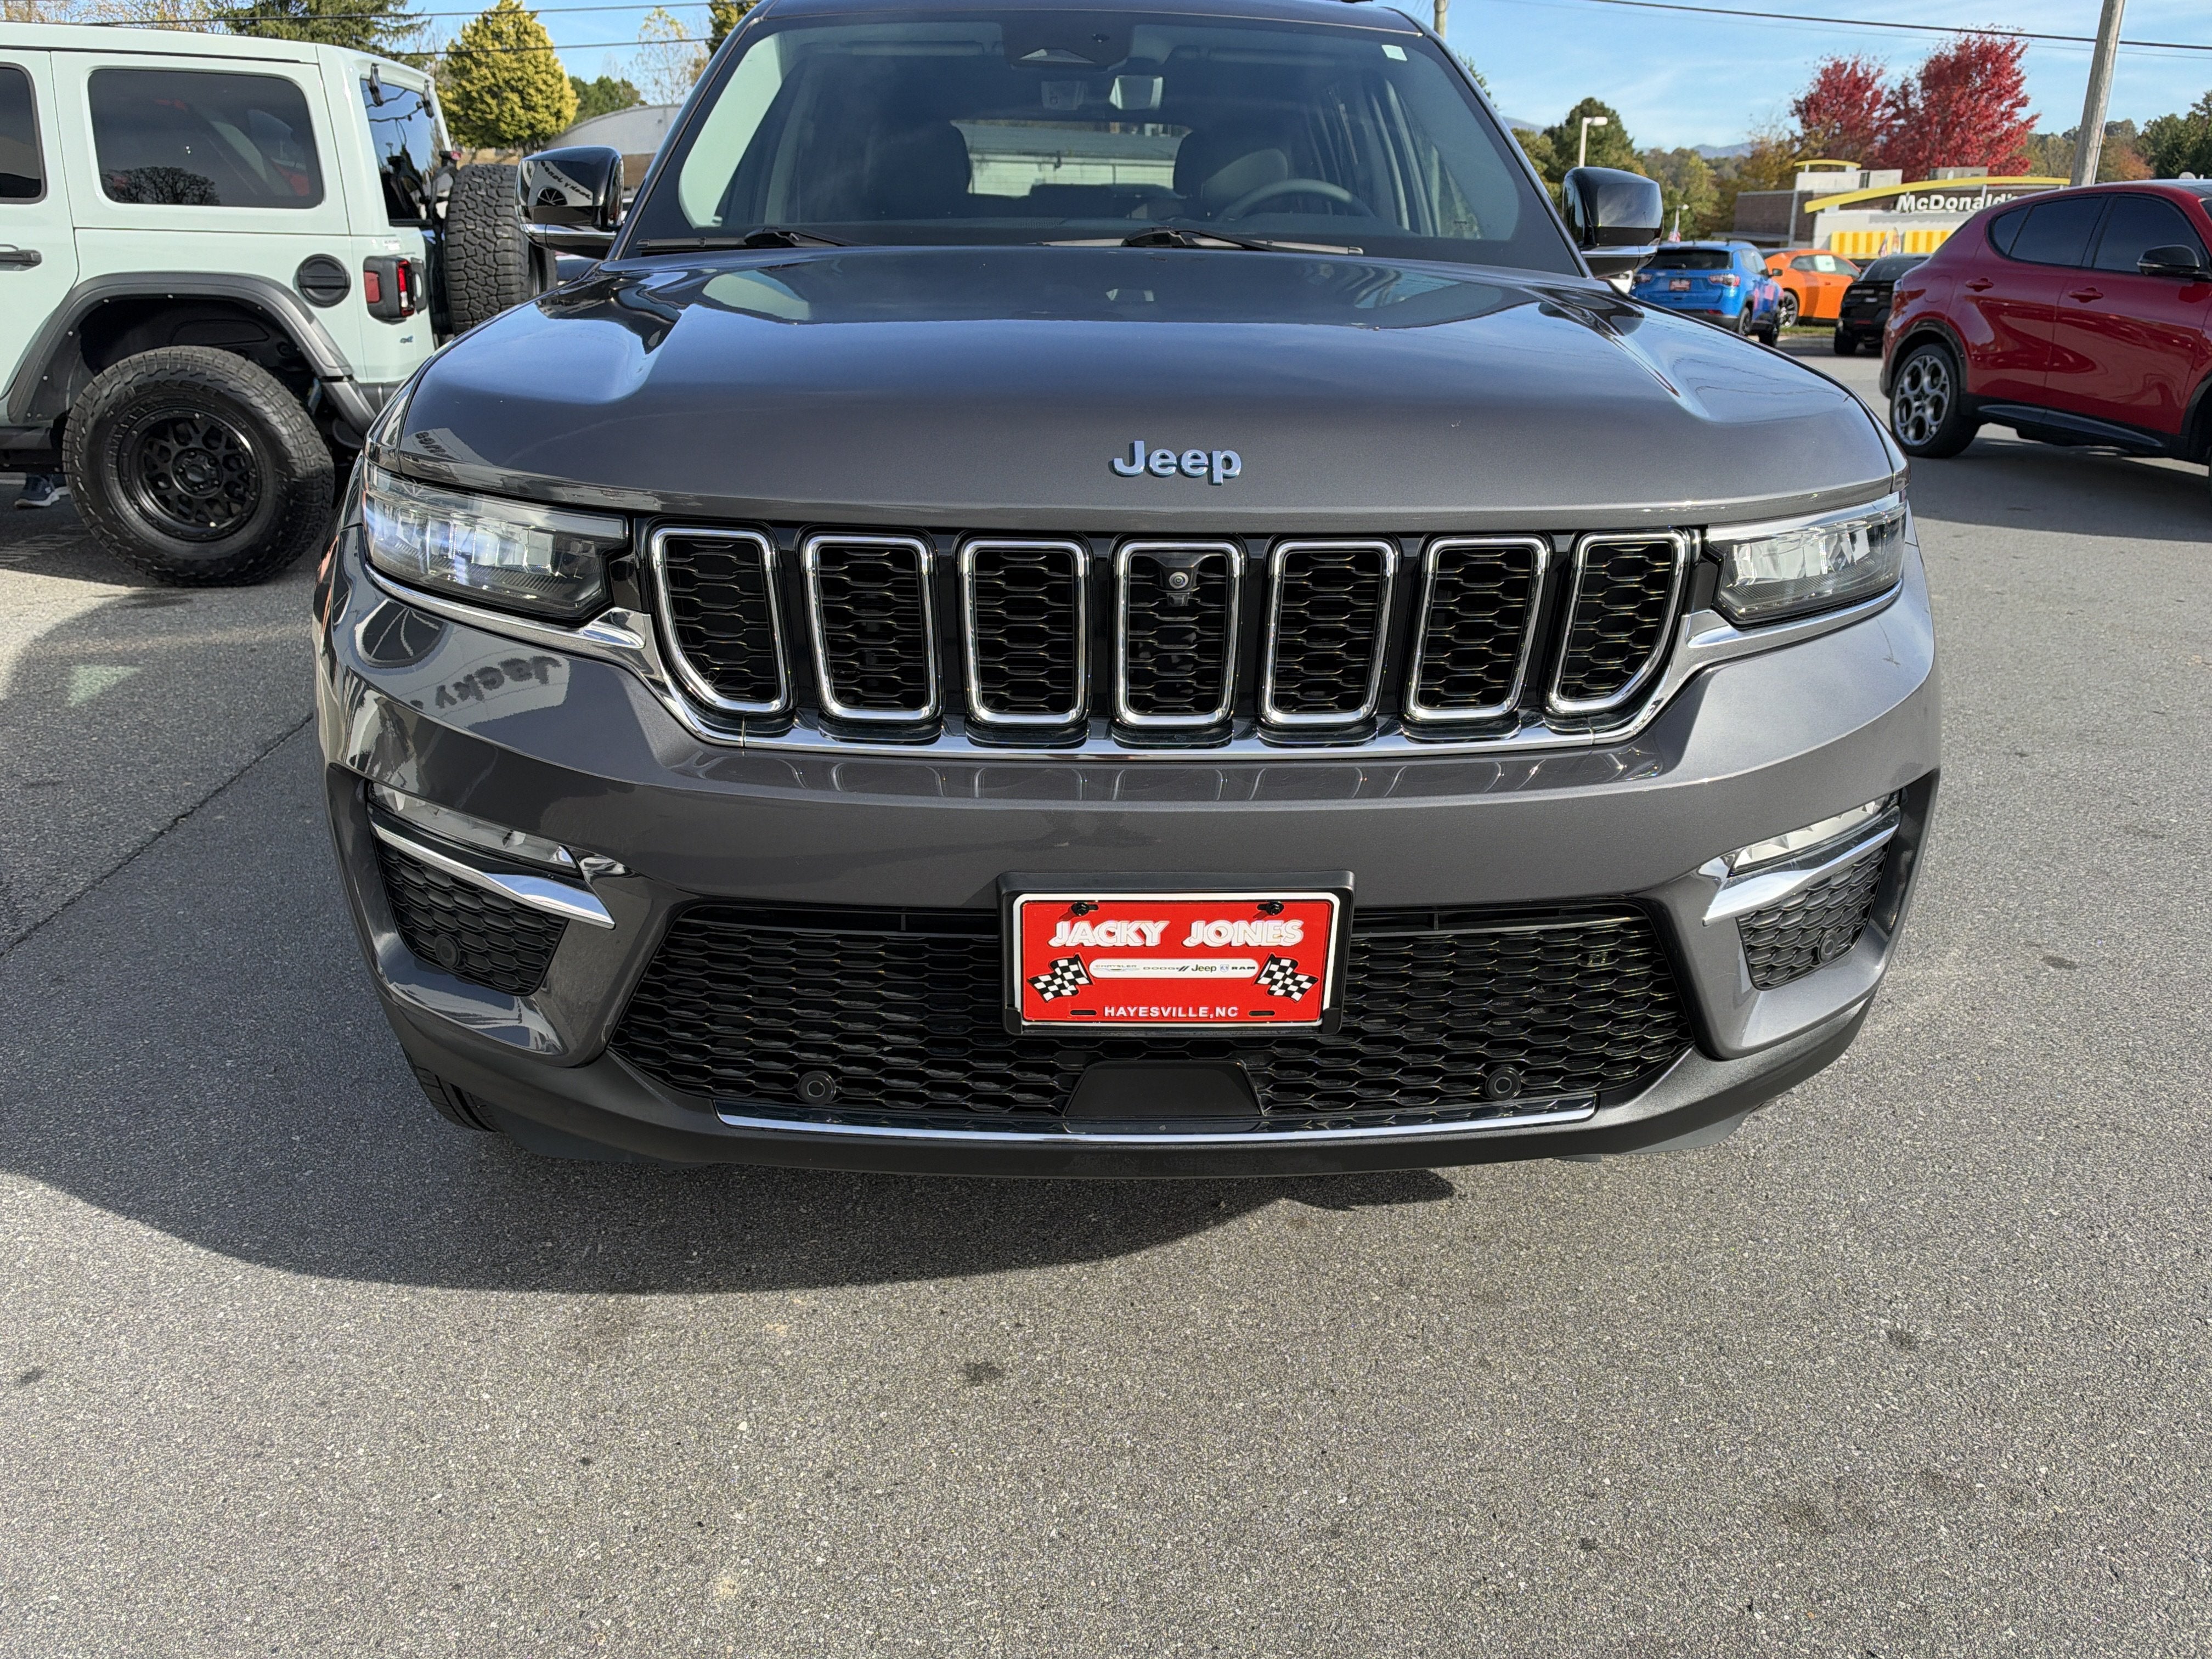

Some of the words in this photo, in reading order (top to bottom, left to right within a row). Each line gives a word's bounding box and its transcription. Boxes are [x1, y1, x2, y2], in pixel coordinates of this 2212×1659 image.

[1896, 193, 2018, 212] McDonald'
[1113, 440, 1242, 486] Jeep
[1048, 919, 1170, 947] JACKY
[1181, 919, 1305, 947] JONES
[1191, 964, 1217, 973] Jeep
[1104, 1006, 1238, 1019] HAYESVILLE,NC
